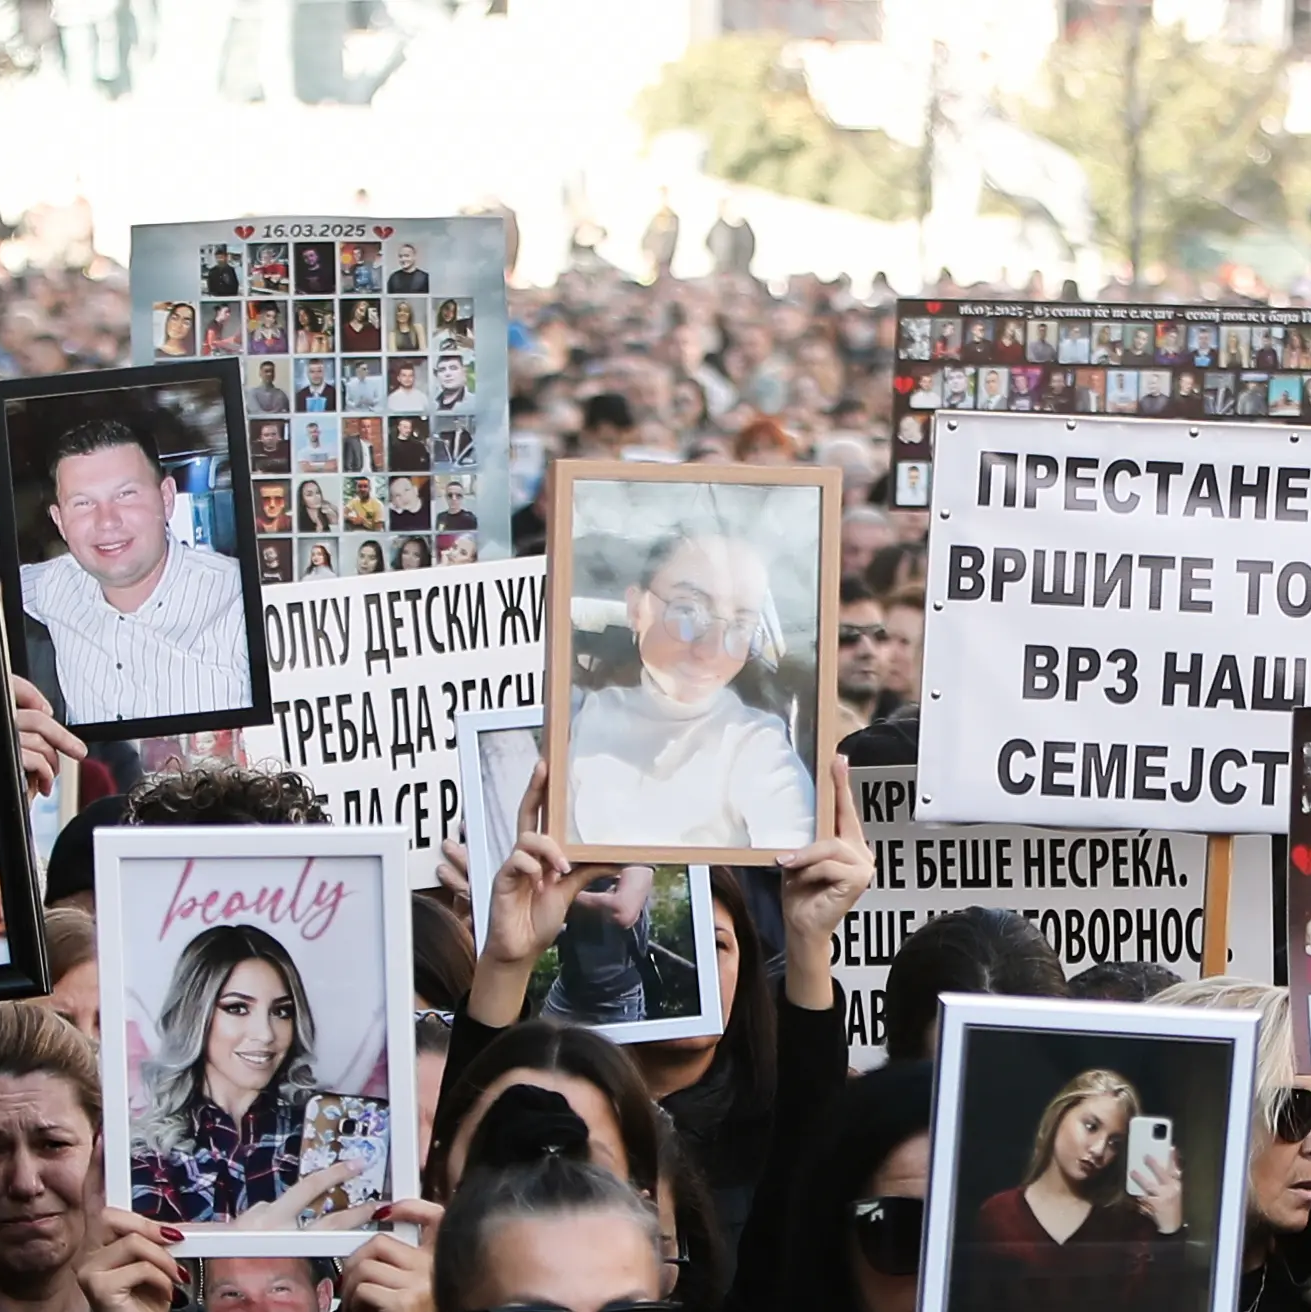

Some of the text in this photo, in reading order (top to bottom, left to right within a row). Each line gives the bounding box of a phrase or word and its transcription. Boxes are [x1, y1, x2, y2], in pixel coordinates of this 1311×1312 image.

[261, 223, 367, 239] 16.03.2025
[946, 544, 1213, 614] ВРШИТЕ
[364, 581, 490, 677] ДЕТСКИ
[1021, 643, 1139, 705] ВРЗ
[273, 691, 383, 769] ТРЕБА
[390, 684, 438, 771] ДА
[995, 737, 1291, 806] СЕМЕЈСТ
[916, 838, 1013, 890] БЕШЕ
[1023, 828, 1189, 888] НЕСРЕЌА.
